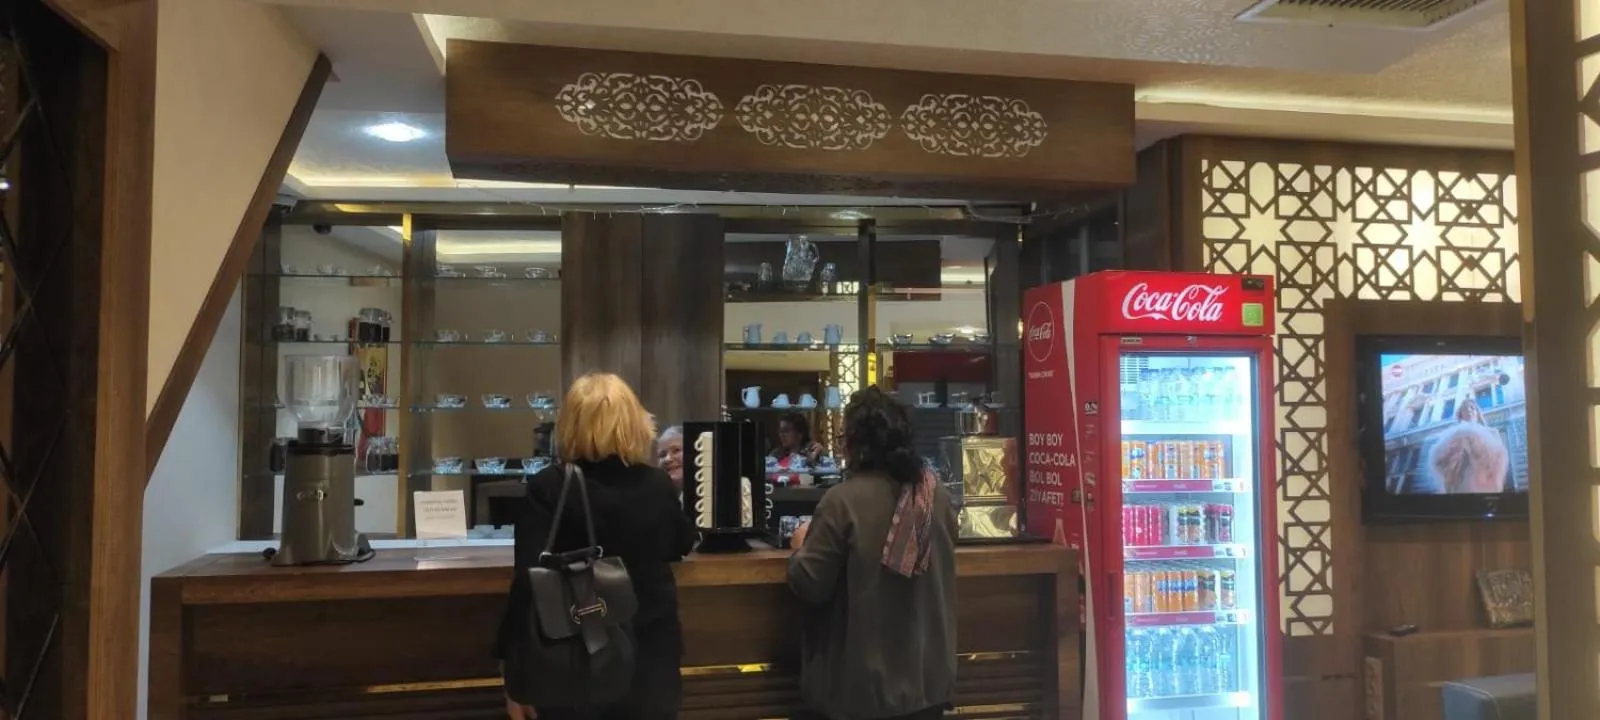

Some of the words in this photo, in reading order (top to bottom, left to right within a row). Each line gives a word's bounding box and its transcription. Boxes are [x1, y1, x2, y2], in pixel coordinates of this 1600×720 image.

[1122, 282, 1229, 322] Coca-Cola
[1028, 432, 1044, 446] BOY
[1046, 433, 1063, 447] BOY
[1028, 451, 1076, 467] COCA-COLA
[1029, 469, 1044, 485] BOL
[1046, 471, 1063, 487] BOL
